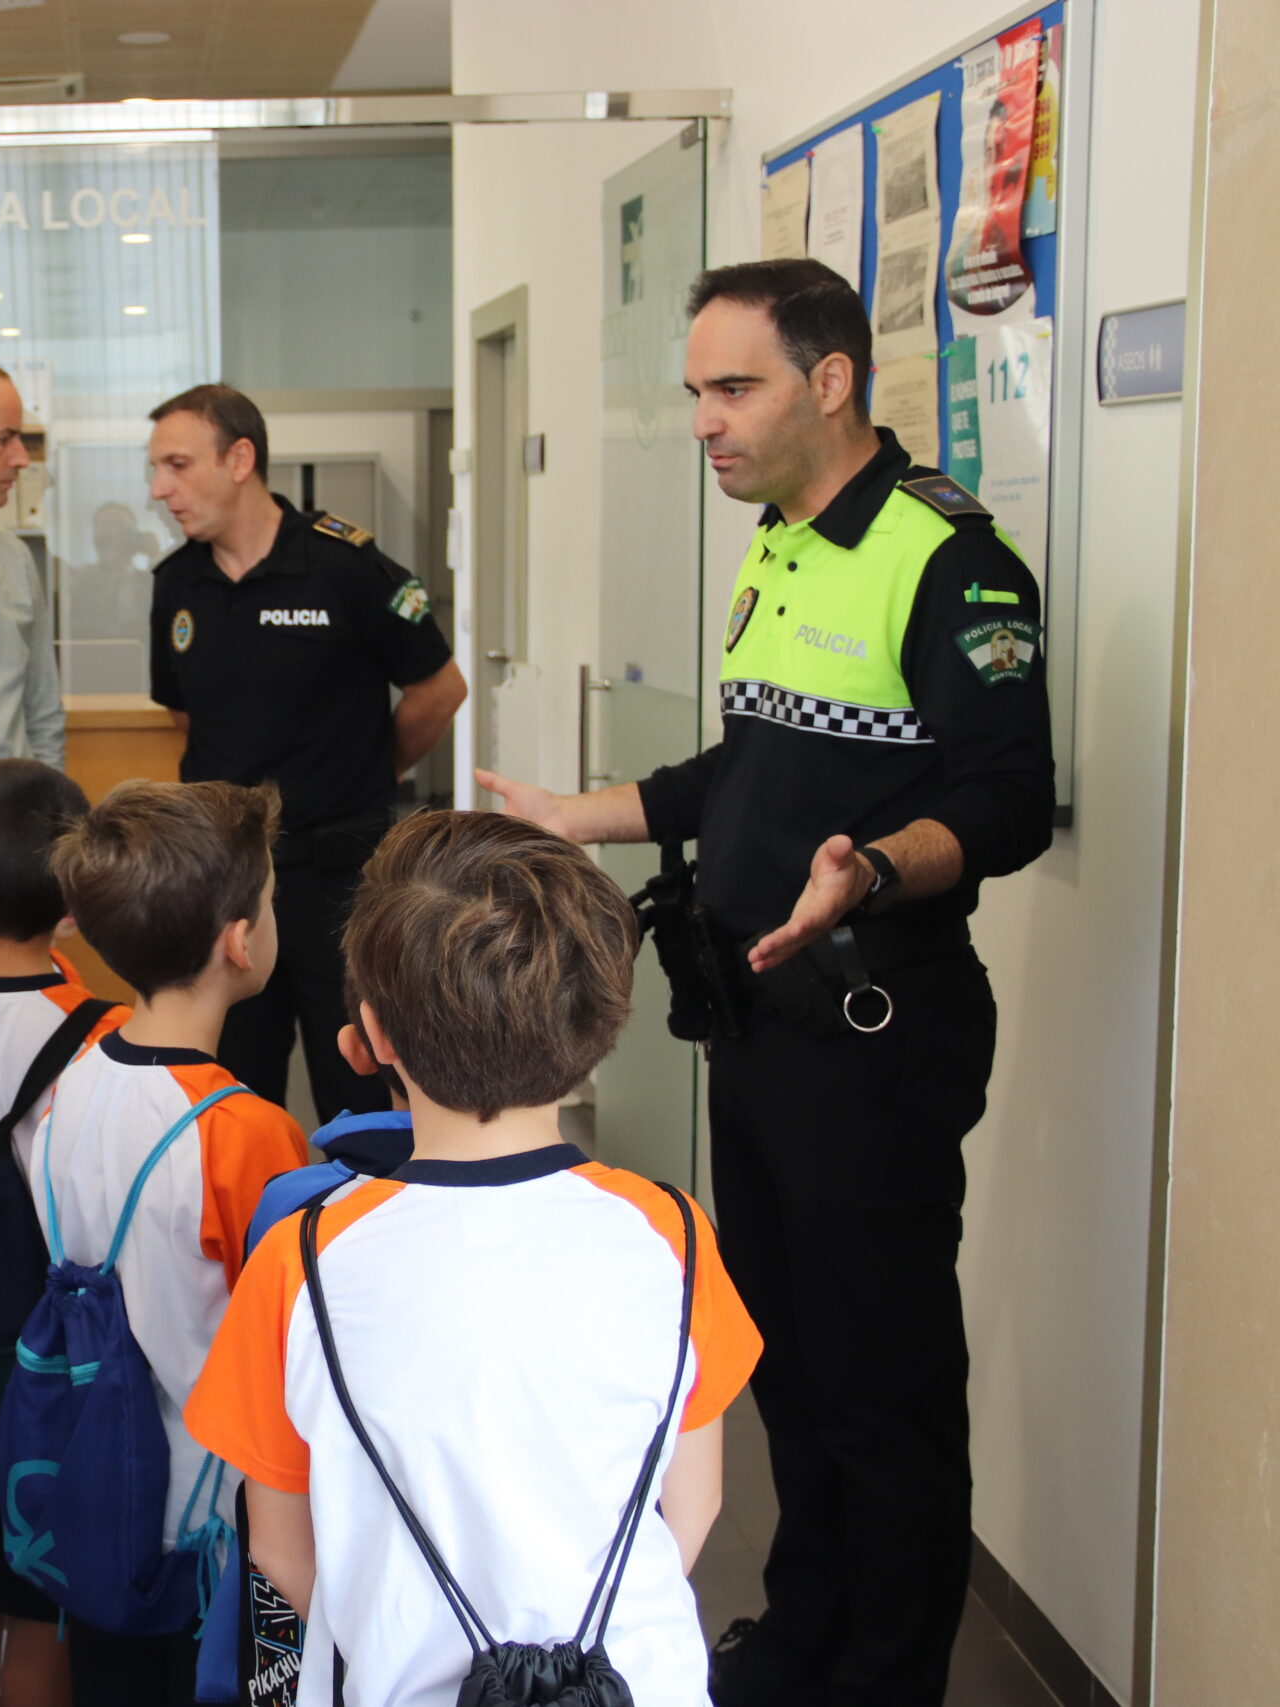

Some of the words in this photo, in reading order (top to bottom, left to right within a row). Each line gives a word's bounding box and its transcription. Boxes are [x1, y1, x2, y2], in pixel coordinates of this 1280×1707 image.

[42, 187, 206, 231] LOCAL
[987, 352, 1030, 404] 112
[259, 609, 330, 626] POLICIA
[963, 621, 1003, 642] POLICIA
[1007, 620, 1033, 634] LOCAL
[793, 624, 868, 660] POLICIA
[248, 1651, 302, 1701] PIKACHU
